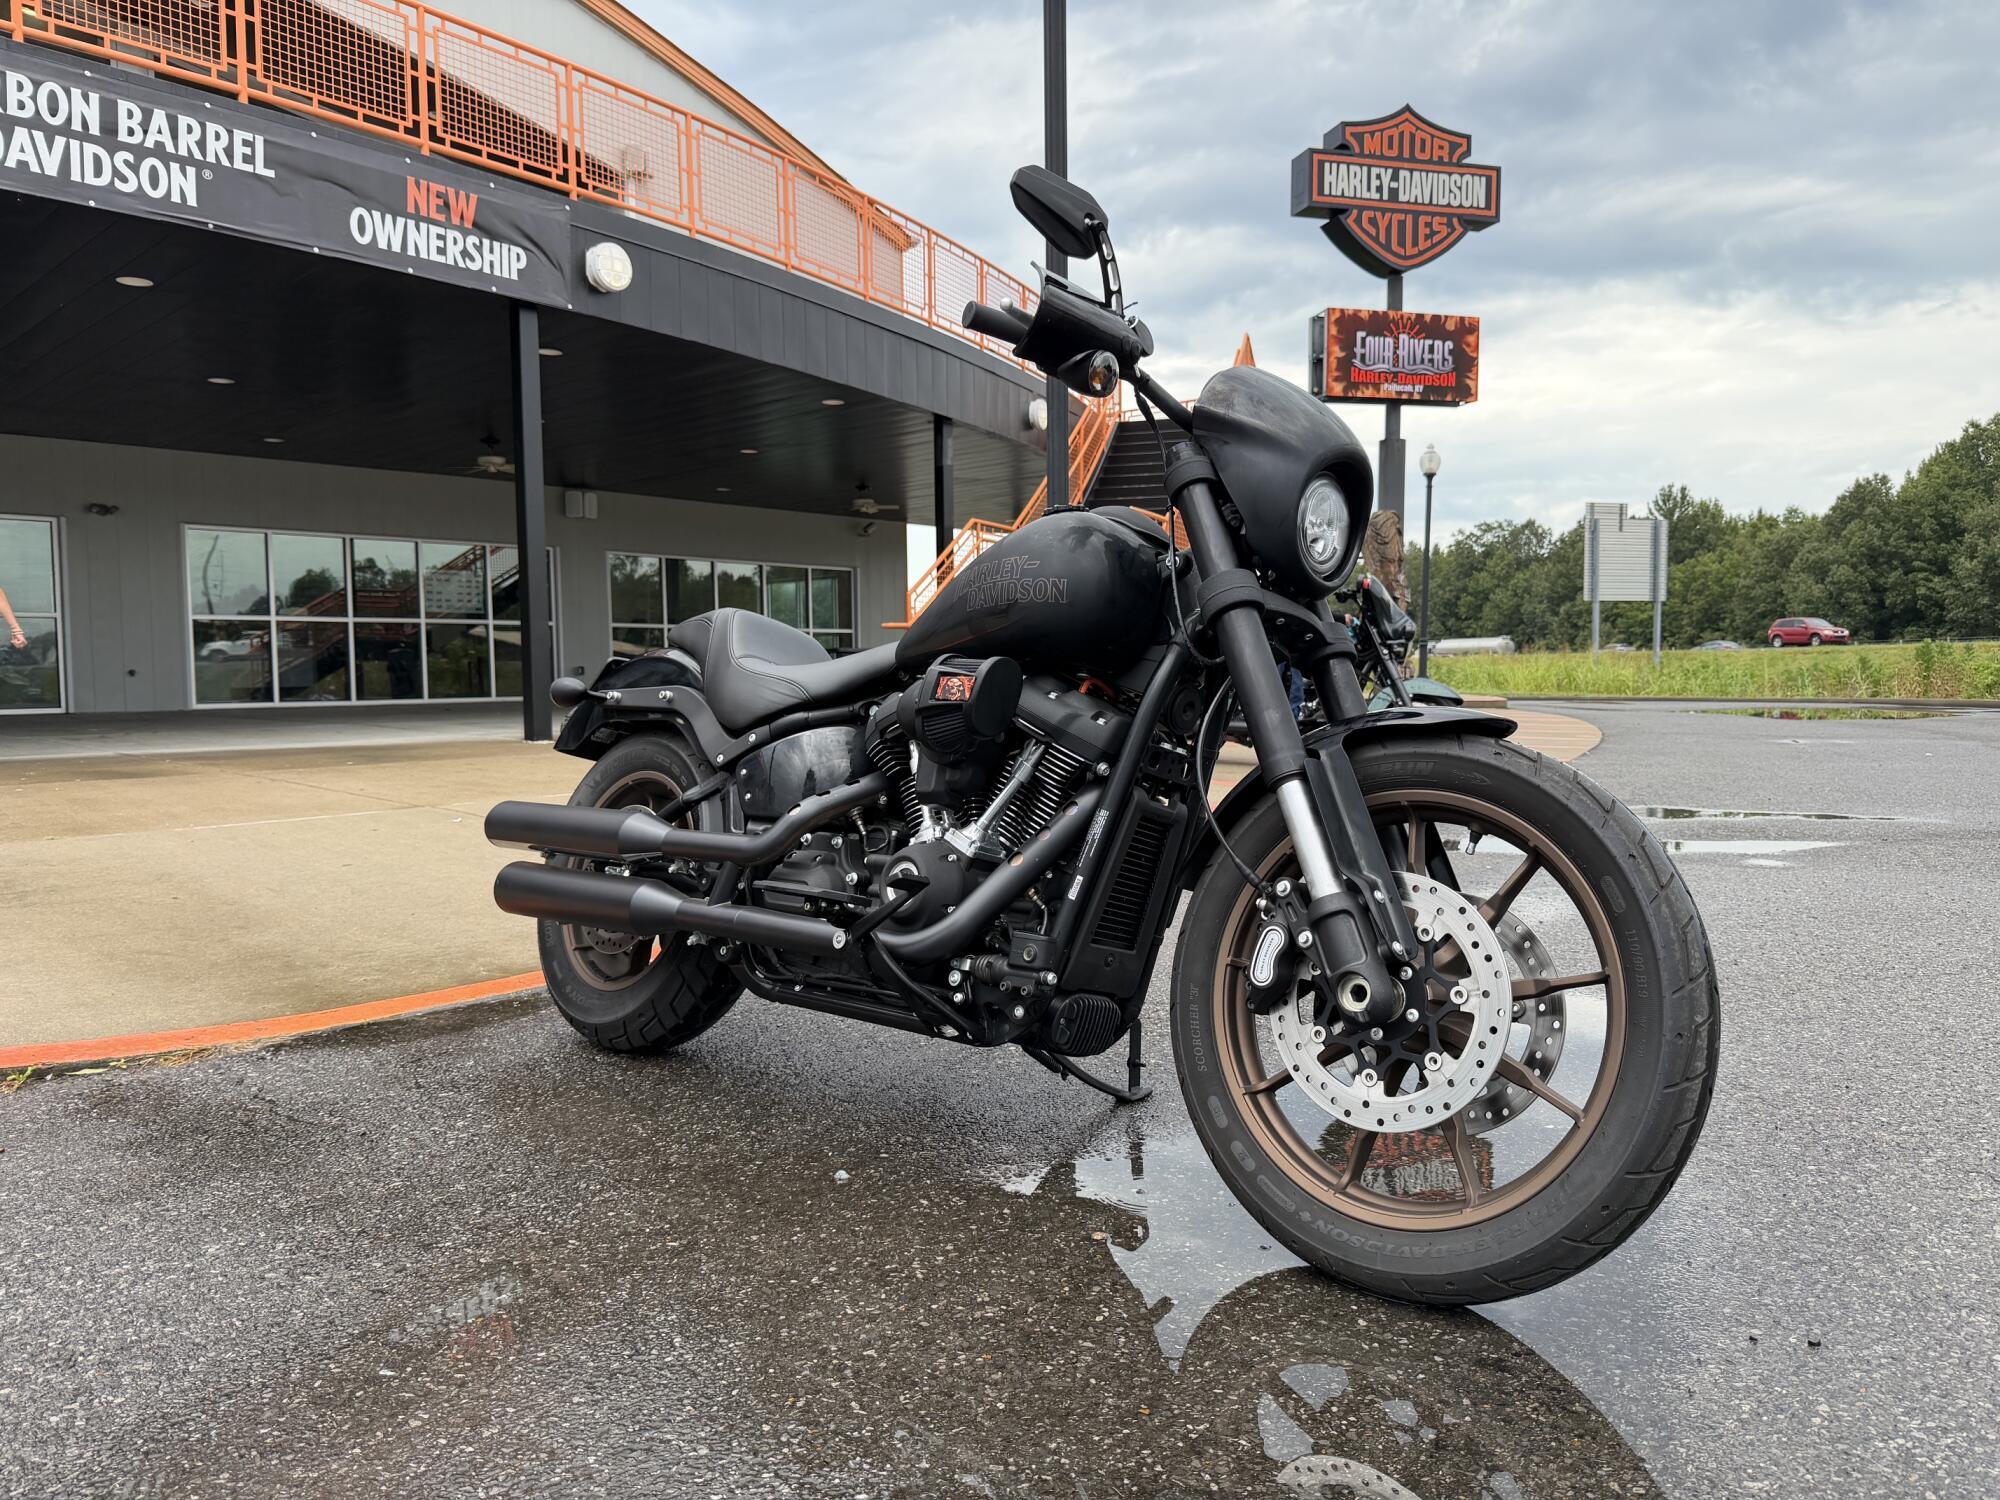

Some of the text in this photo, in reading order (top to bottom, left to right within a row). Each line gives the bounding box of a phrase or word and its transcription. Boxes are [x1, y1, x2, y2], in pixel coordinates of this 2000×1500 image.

[0, 70, 276, 178] BON BARREL
[1363, 122, 1450, 163] MOTOR
[406, 175, 478, 229] NEW
[1323, 161, 1487, 208] HARLEY-DAVIDSON
[350, 206, 528, 280] OWNERSHIP
[1361, 209, 1448, 256] CYCLES
[1353, 331, 1454, 370] FOUR RIVERS
[1350, 367, 1456, 387] HARLEY-DAVIDSON
[966, 578, 1068, 612] DAVIDSON
